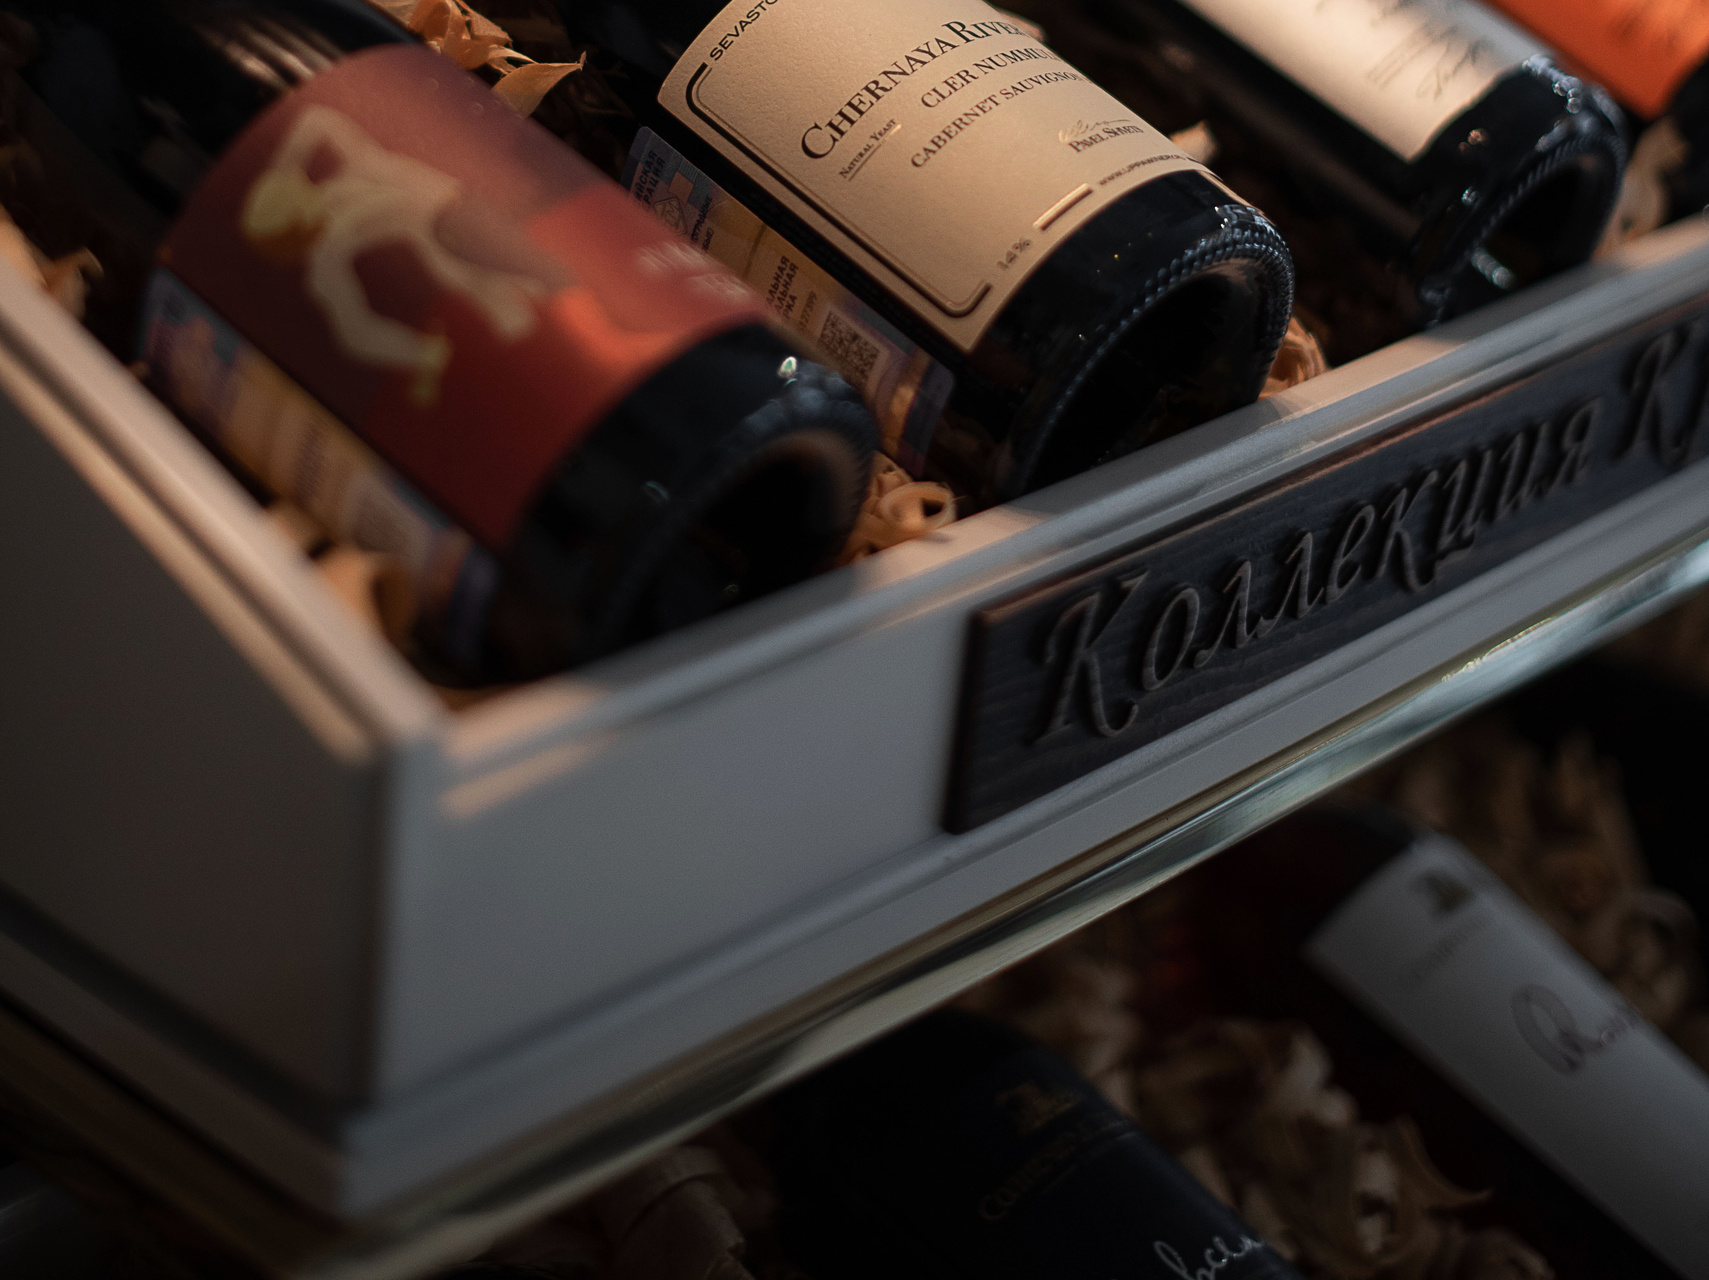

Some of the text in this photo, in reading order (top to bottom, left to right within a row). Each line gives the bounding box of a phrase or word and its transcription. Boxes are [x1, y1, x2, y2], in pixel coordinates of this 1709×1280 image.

[921, 69, 979, 109] CLER
[911, 94, 1001, 168] CABERNET
[1068, 133, 1110, 153] PAVEL
[766, 255, 790, 306] АЛЬНАЯ
[774, 263, 799, 314] АЛЬНАЯ
[1032, 396, 1602, 741] Коллекция
